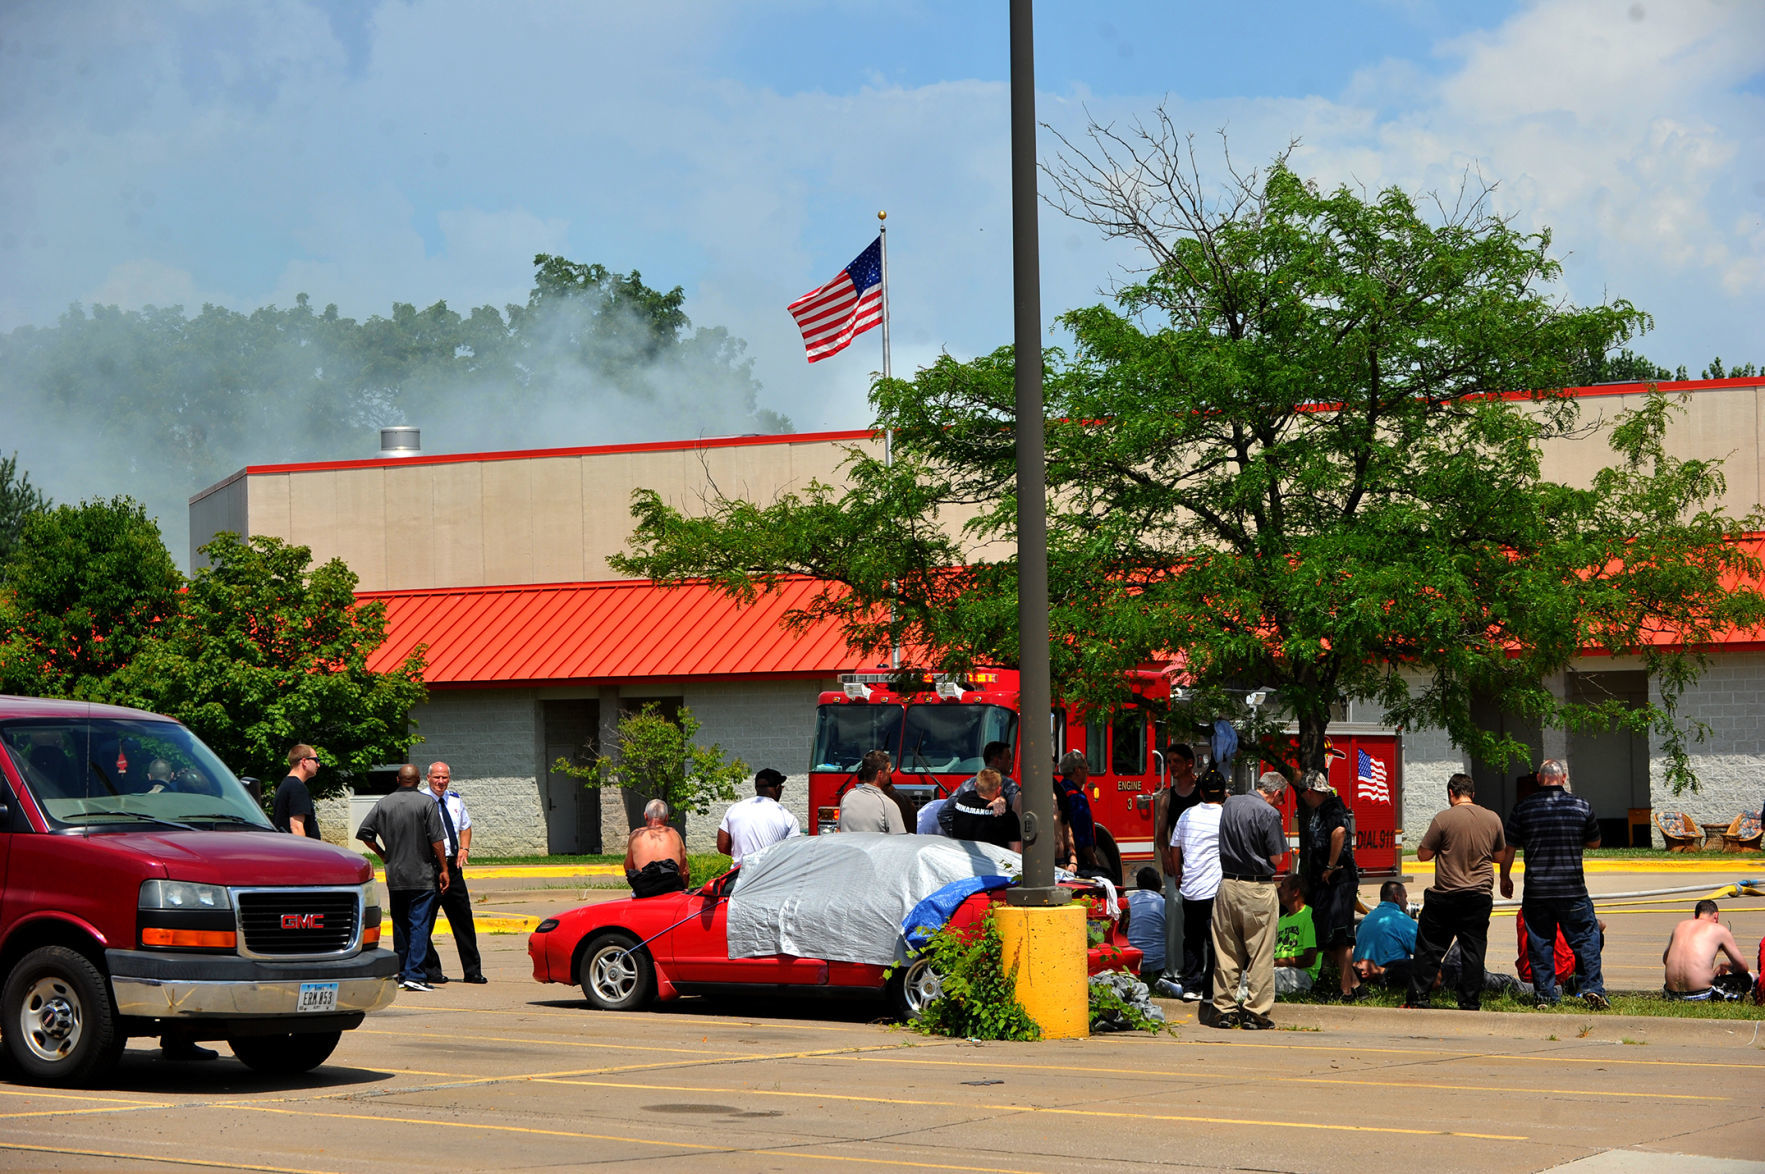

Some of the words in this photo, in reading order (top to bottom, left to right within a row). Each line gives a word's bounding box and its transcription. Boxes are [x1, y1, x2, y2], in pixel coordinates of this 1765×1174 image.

[1117, 780, 1142, 791] ENGINE
[1127, 797, 1133, 810] 3
[1356, 830, 1378, 849] DIAL
[1379, 829, 1395, 849] 911
[280, 913, 325, 929] GMC
